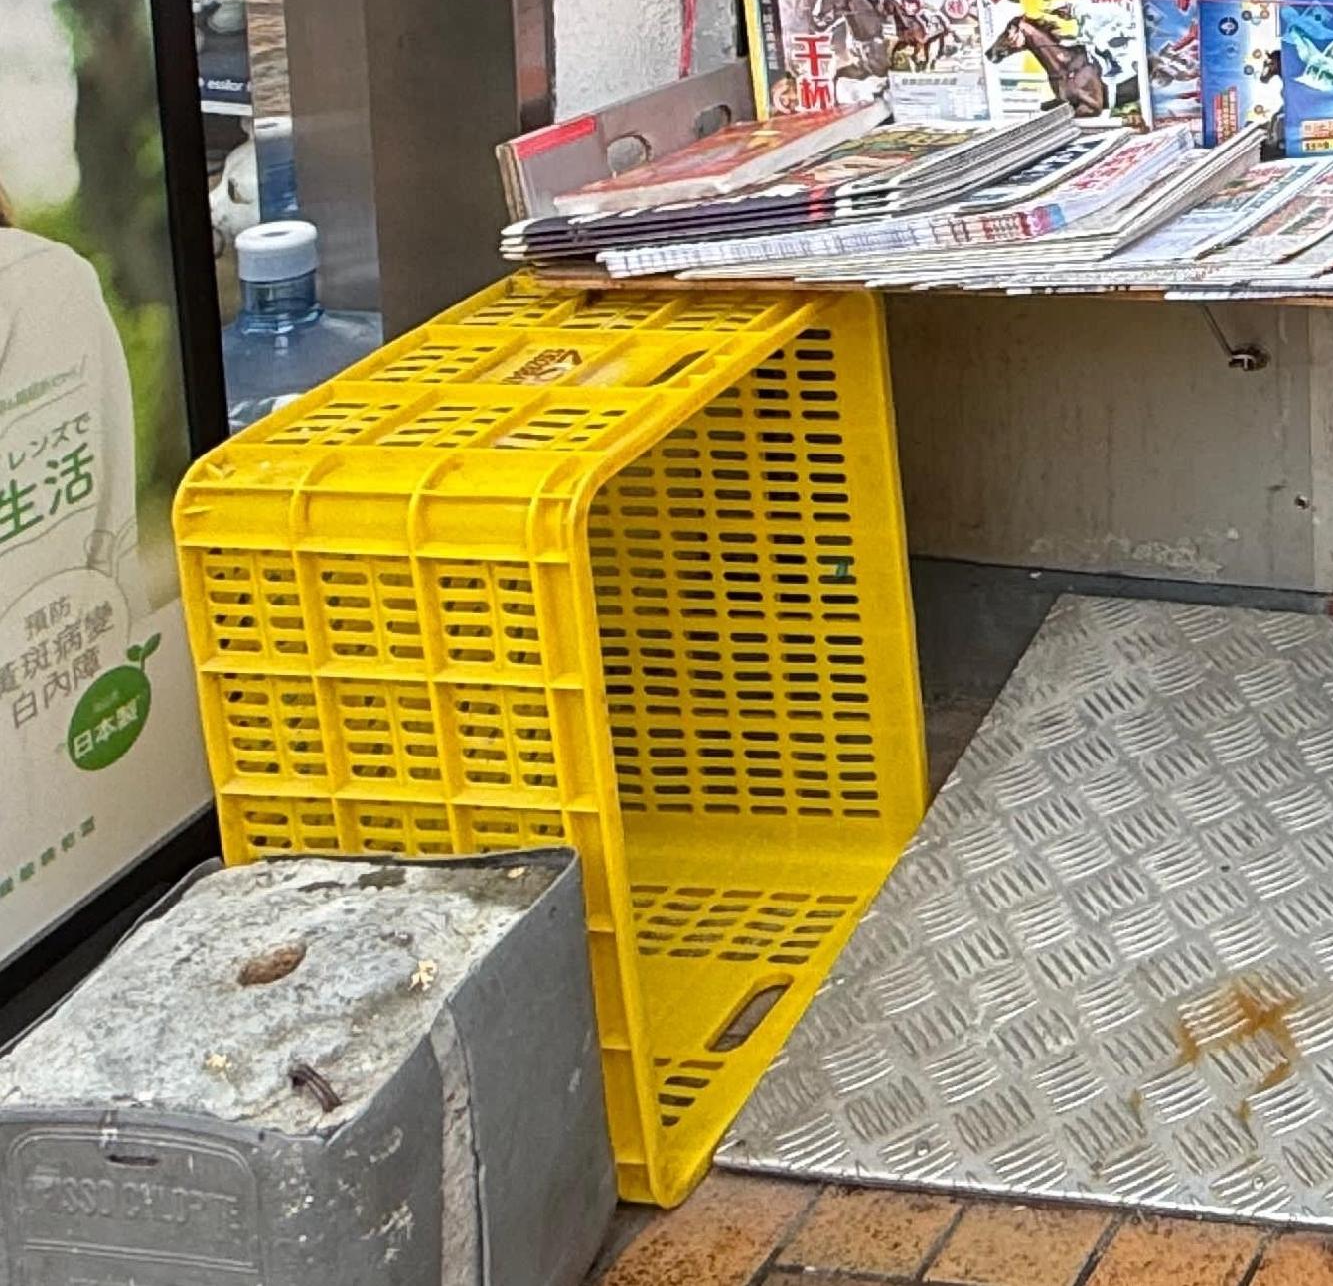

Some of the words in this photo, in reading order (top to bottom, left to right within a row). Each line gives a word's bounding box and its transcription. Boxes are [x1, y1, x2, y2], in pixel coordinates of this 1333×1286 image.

[8, 411, 92, 471] レンズで
[0, 442, 95, 543] 生活
[24, 594, 72, 642] 預防
[72, 696, 140, 760] 日本製
